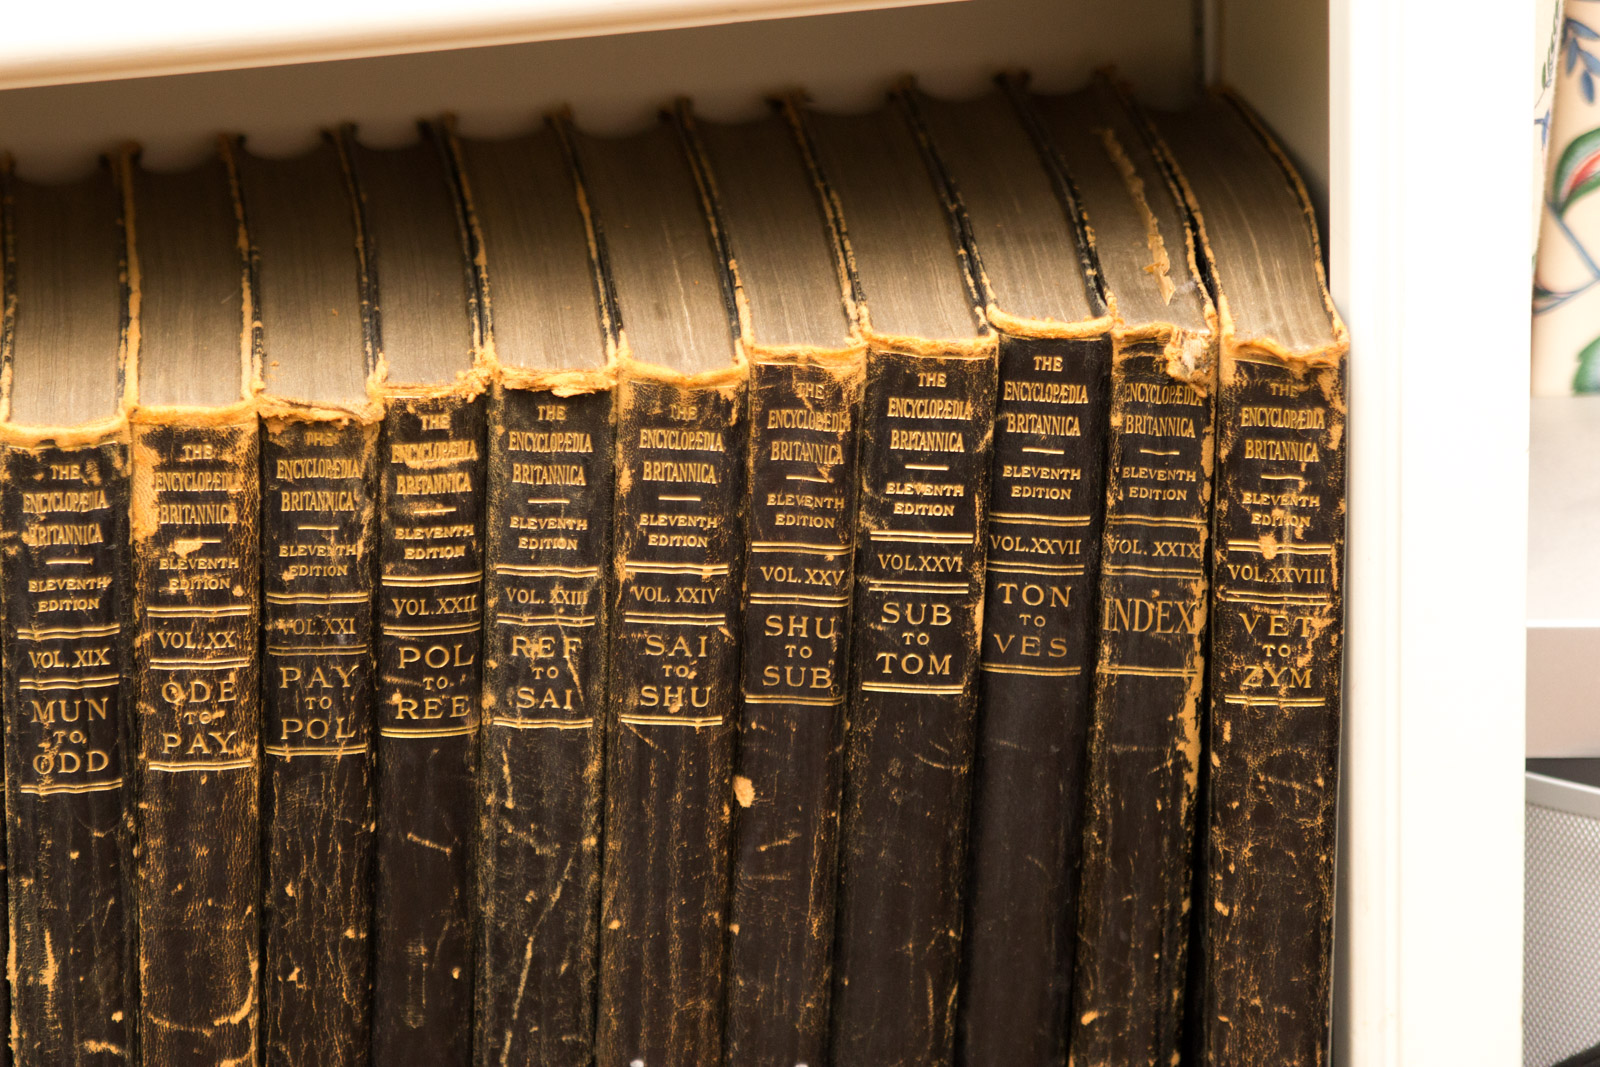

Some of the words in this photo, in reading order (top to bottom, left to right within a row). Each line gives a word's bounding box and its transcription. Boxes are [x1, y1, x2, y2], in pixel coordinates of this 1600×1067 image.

[1033, 356, 1063, 372] THE
[918, 373, 947, 387] THE
[797, 383, 824, 399] THE
[1270, 382, 1299, 397] THE
[538, 406, 567, 420] THE
[670, 405, 698, 421] THE
[421, 414, 451, 429] THE
[1006, 413, 1081, 437] BRITANNICA
[1125, 415, 1196, 438] BRITANNICA
[890, 430, 965, 453] BRITANNICA
[182, 445, 213, 460] THE
[770, 441, 845, 464] BRITANNICA
[1245, 440, 1319, 462] BRITANNICA
[50, 464, 81, 480] THE
[512, 463, 586, 486] BRITANNICA
[643, 461, 717, 484] BRITANNICA
[1003, 465, 1081, 481] ELEVENTH
[1122, 467, 1196, 482] ELEVENTH
[885, 482, 964, 497] ELEVENTH
[1011, 486, 1072, 500] EDITION
[1129, 487, 1188, 501] EDITION
[281, 491, 355, 512] BRITANNICA
[767, 494, 845, 509] ELEVENTH
[1242, 493, 1320, 507] ELEVENTH
[893, 503, 955, 517] EDITION
[510, 516, 588, 530] ELEVENTH
[640, 514, 718, 528] ELEVENTH
[775, 514, 835, 529] EDITION
[1251, 513, 1311, 527] EDITION
[28, 523, 103, 546] BRITANNICA
[395, 525, 474, 540] ELEVENTH
[518, 537, 578, 550] EDITION
[648, 535, 708, 548] EDITION
[279, 545, 358, 557] ELEVENTH
[404, 546, 465, 560] EDITION
[159, 558, 239, 570] ELEVENTH
[289, 565, 348, 576] EDITION
[28, 578, 109, 592] ELEVENTH
[169, 577, 230, 590] EDITION
[998, 583, 1071, 608] TON
[38, 599, 99, 613] EDITION
[881, 603, 952, 626] SUB
[1019, 614, 1046, 628] TO
[1103, 598, 1198, 634] INDEX
[765, 615, 836, 639] SHU
[1239, 613, 1313, 638] VET
[645, 635, 707, 657] SAI
[902, 632, 930, 645] TO
[993, 634, 1068, 658] VES
[511, 636, 582, 658] REF
[785, 645, 812, 659] TO
[1262, 644, 1291, 657] TO
[398, 644, 474, 668] POL
[662, 665, 689, 677] TO
[876, 653, 952, 676] TOM
[279, 665, 359, 689] PAY
[532, 666, 559, 680] TO
[762, 666, 832, 689] SUB
[1242, 665, 1313, 688] ZYM
[423, 677, 448, 690] TO
[161, 681, 237, 704] ODE
[516, 687, 573, 709] SAI
[640, 686, 711, 708] SHU
[31, 697, 109, 723] MUN
[305, 696, 332, 709] TO
[395, 696, 471, 720] REE
[184, 712, 212, 724] TO
[281, 718, 356, 739] POL
[53, 731, 84, 744] TO
[162, 731, 237, 754] PAY
[33, 751, 109, 774] ODD
